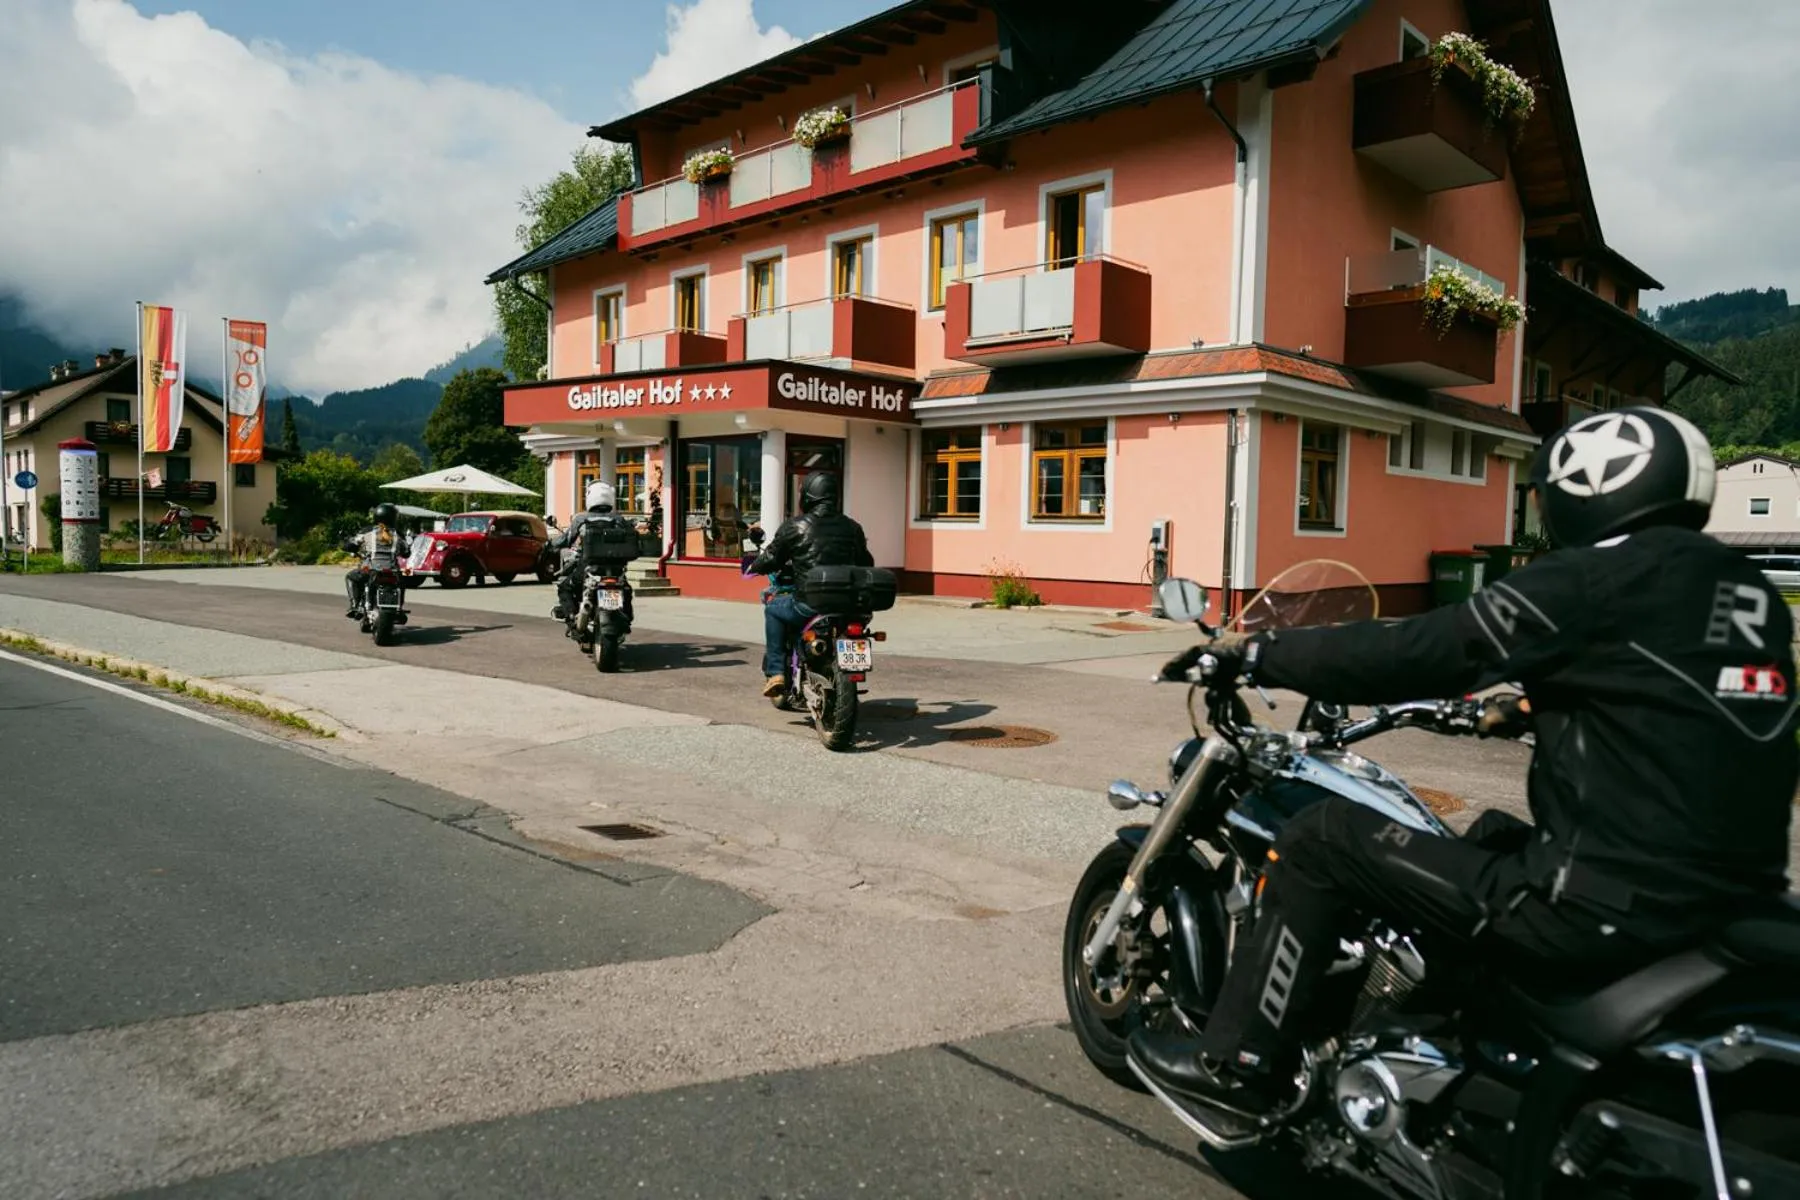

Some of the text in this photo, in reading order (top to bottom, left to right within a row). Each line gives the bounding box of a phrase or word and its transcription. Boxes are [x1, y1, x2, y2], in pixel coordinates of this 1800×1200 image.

[567, 378, 683, 410] Gailtaler Hof
[777, 372, 903, 412] Gailtaler Hof
